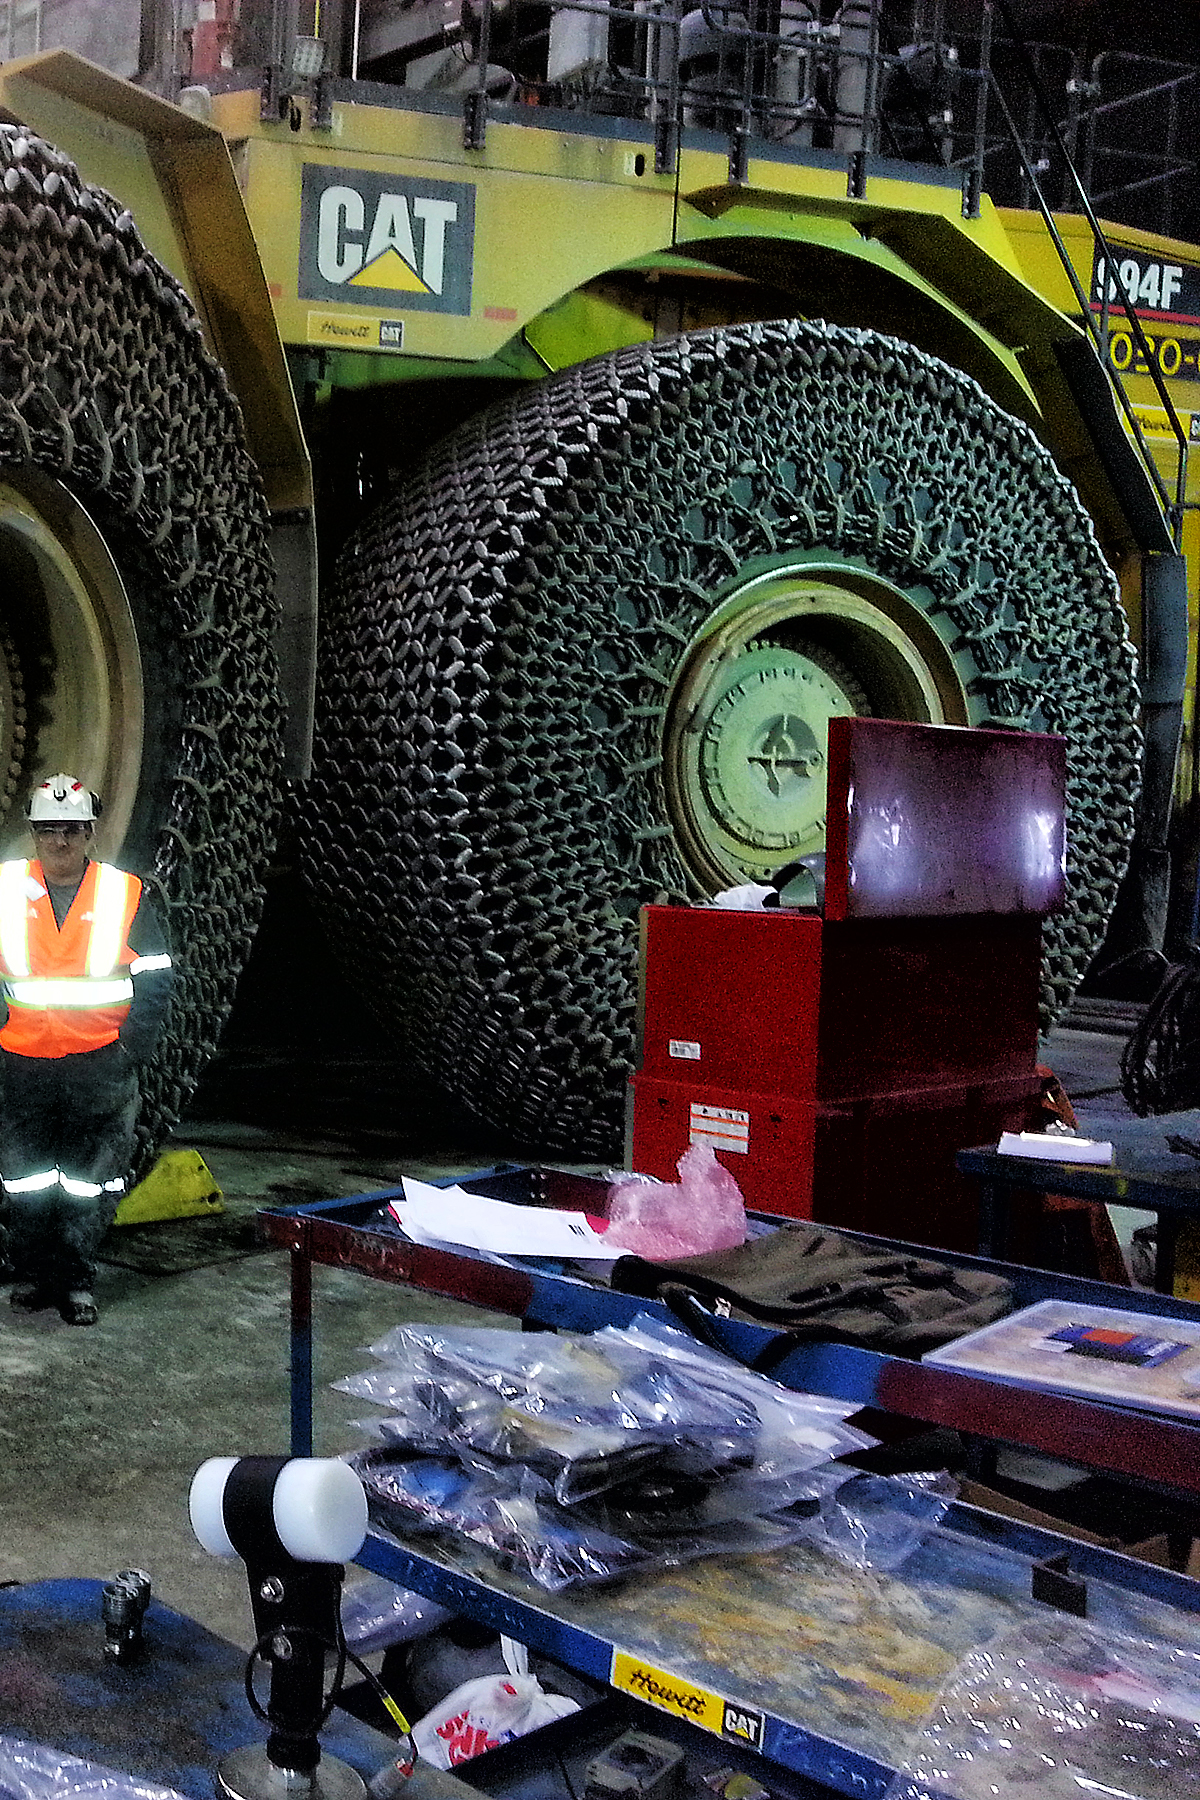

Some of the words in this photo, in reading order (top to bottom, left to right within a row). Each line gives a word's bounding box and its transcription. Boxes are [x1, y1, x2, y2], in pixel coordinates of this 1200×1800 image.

[317, 185, 457, 295] CAT
[381, 326, 401, 342] CAT
[725, 1707, 759, 1743] CAT
